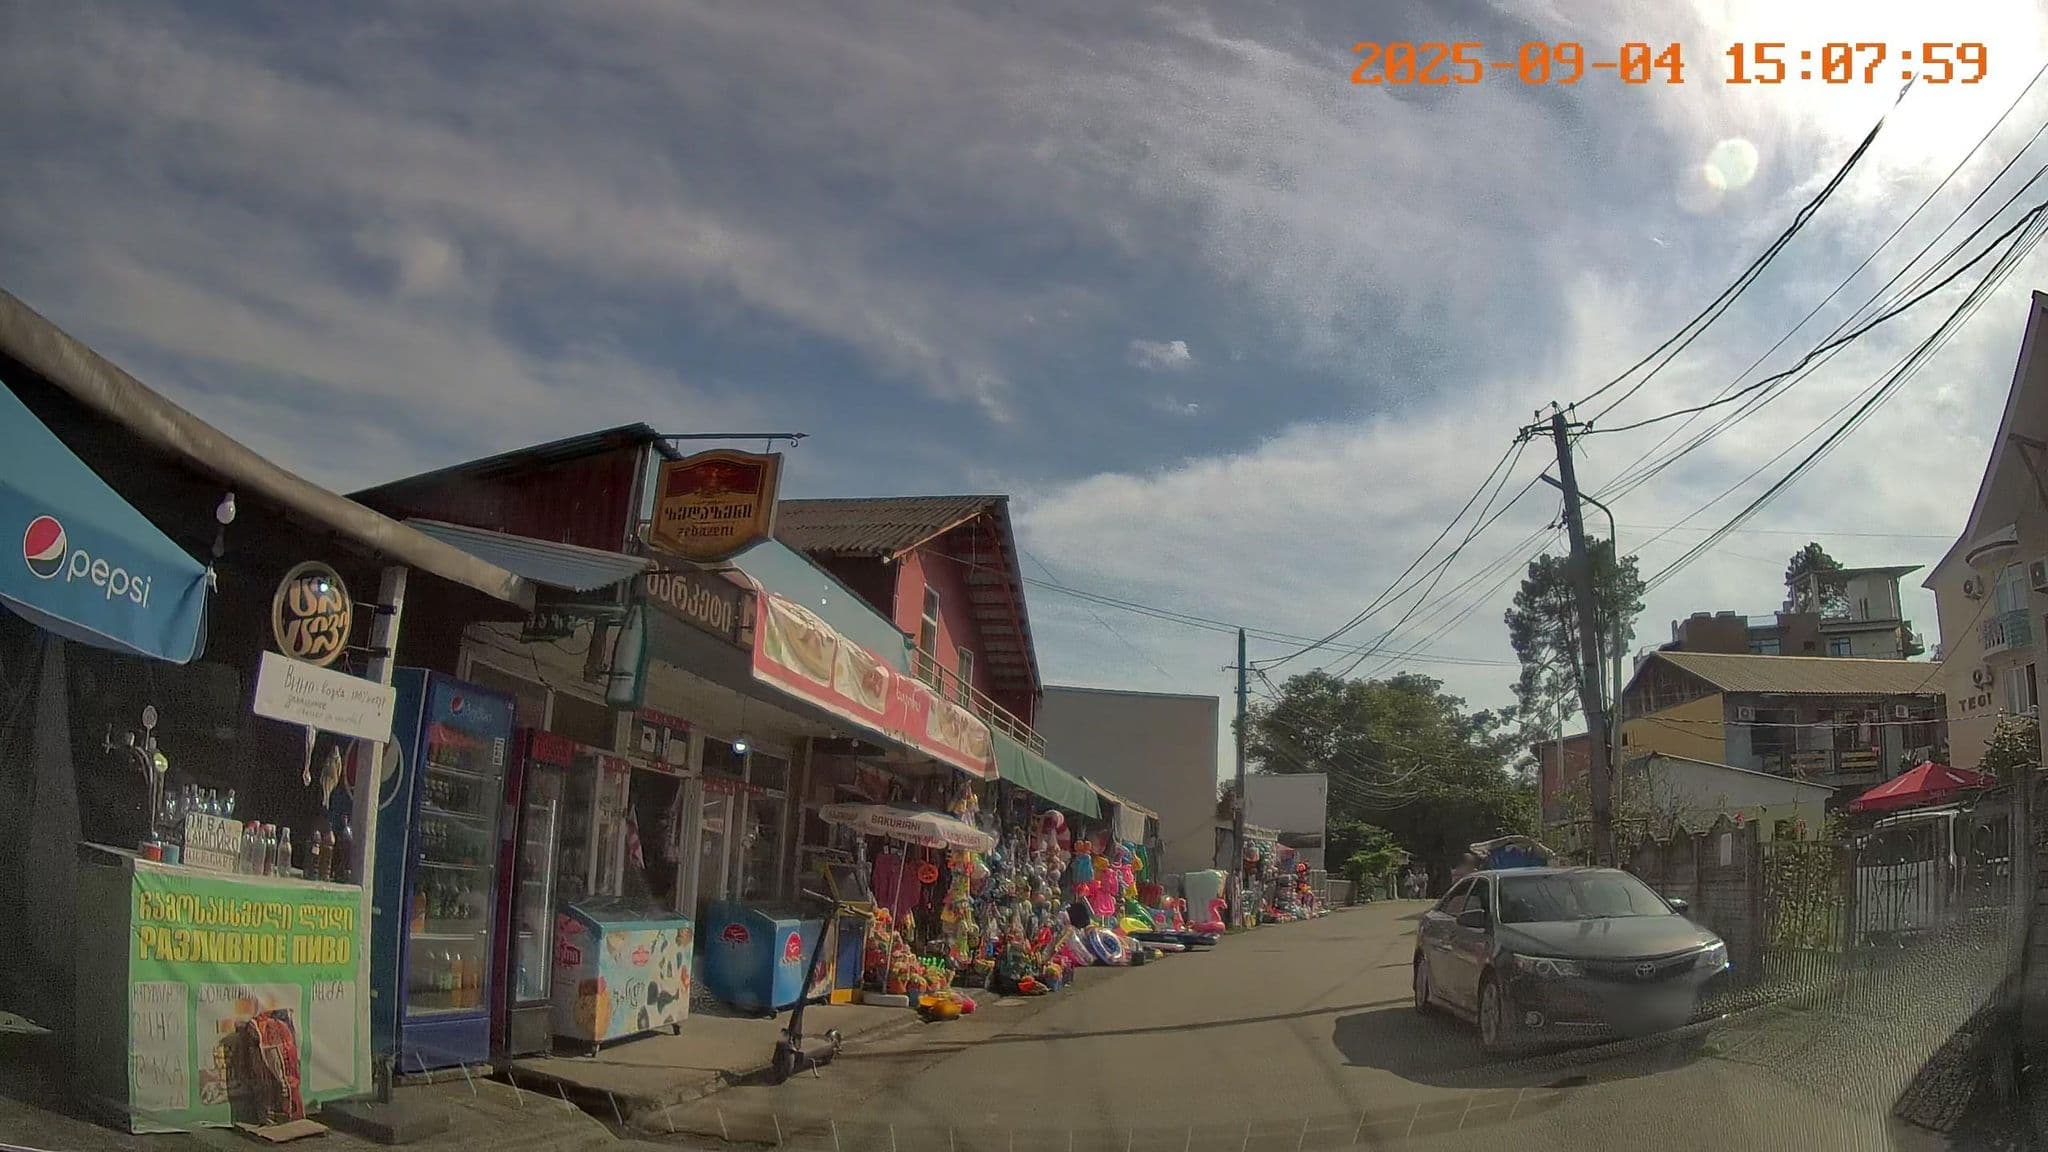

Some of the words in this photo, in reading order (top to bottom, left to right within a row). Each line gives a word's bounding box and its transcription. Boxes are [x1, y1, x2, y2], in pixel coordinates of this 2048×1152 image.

[67, 545, 153, 609] pepsi
[646, 560, 732, 633] მარკეტი
[871, 814, 922, 832] BAKURIANI
[299, 902, 354, 932] ლუდი
[138, 925, 288, 965] РАЗЛИВНОЕ
[292, 934, 352, 966] ПИВО
